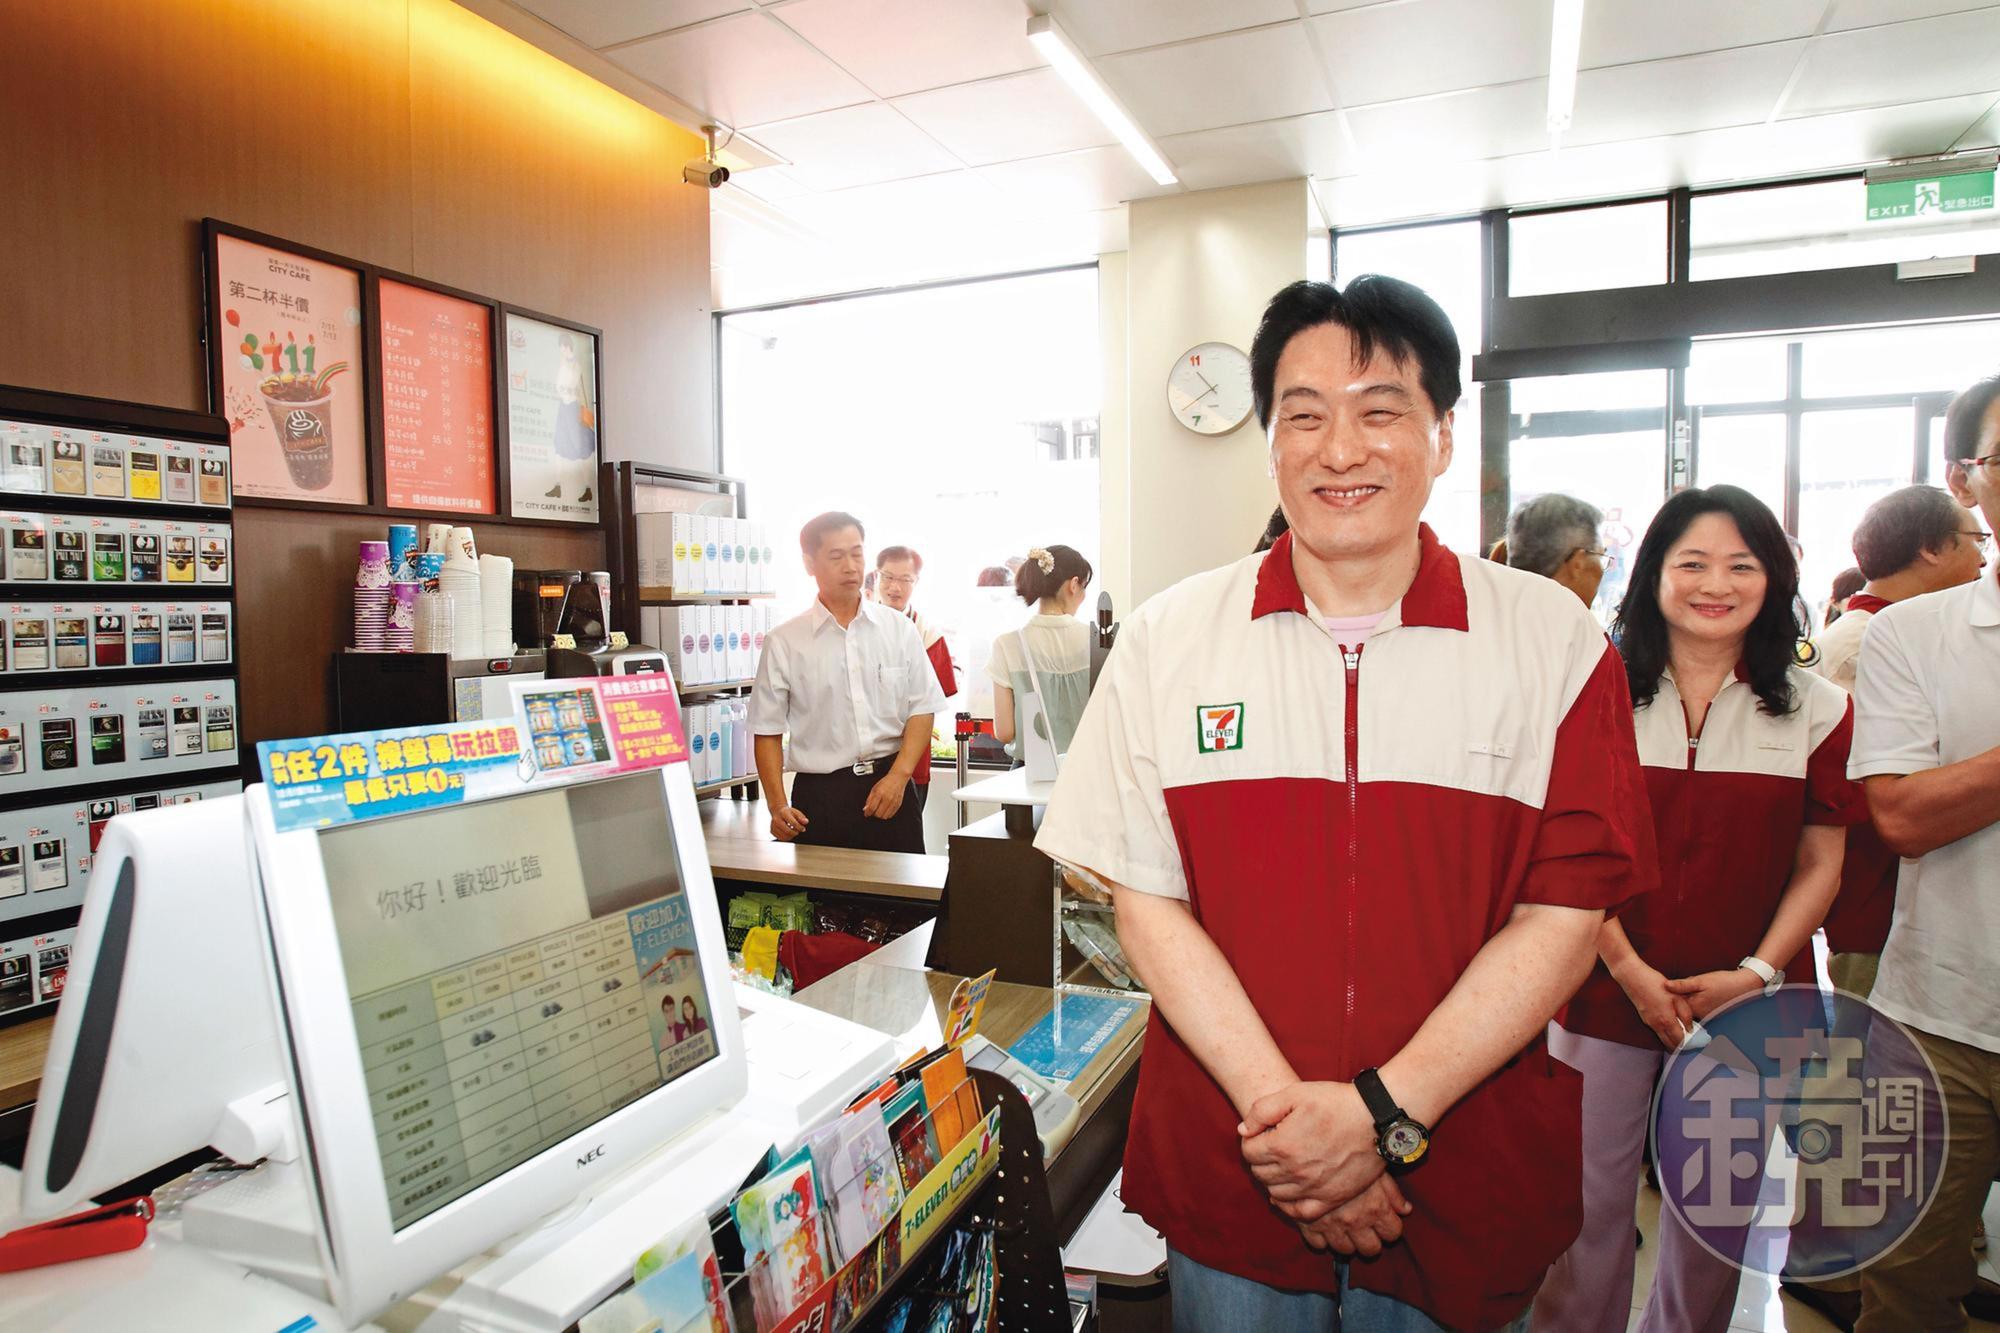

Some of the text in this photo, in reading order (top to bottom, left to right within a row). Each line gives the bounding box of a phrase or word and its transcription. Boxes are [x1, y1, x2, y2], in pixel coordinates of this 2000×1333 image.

[1944, 195, 1993, 209] 緊急出口
[1869, 204, 1909, 217] EXIT
[268, 265, 287, 275] CITY
[289, 270, 311, 281] CAFE
[229, 280, 310, 313] 第二杯半價
[1190, 355, 1200, 366] 11
[1192, 415, 1201, 426] 7
[541, 503, 557, 511] CAFE
[1207, 709, 1235, 749] 7
[375, 727, 520, 771] 按螢幕玩拉霸
[631, 902, 687, 936] 歡迎加入
[577, 1143, 607, 1169] NEC
